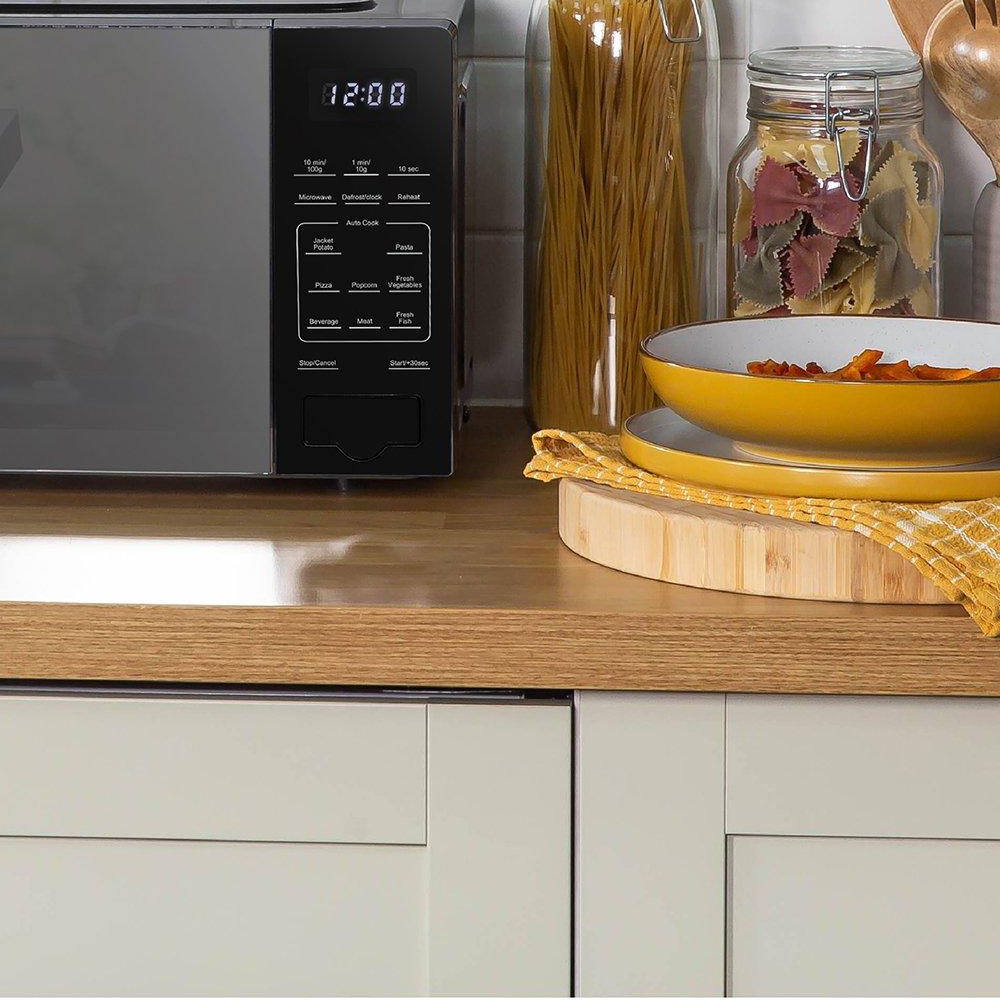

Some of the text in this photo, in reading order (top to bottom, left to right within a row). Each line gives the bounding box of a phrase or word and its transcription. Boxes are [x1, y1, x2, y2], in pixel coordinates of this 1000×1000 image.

[330, 81, 406, 108] 12:00
[302, 158, 327, 166] 10 min/
[356, 158, 371, 166] min/
[307, 165, 323, 174] 100g
[355, 165, 368, 174] 10g
[298, 193, 332, 201] Microwave
[397, 193, 421, 201] Reheat
[345, 219, 380, 227] Auto Cook
[395, 243, 414, 251] Pasta
[314, 281, 333, 289] Pizza
[351, 281, 378, 290] Popcorn
[387, 281, 423, 290] Vegetables
[308, 318, 339, 326] Beverage
[298, 359, 337, 367] Stop/Cancel
